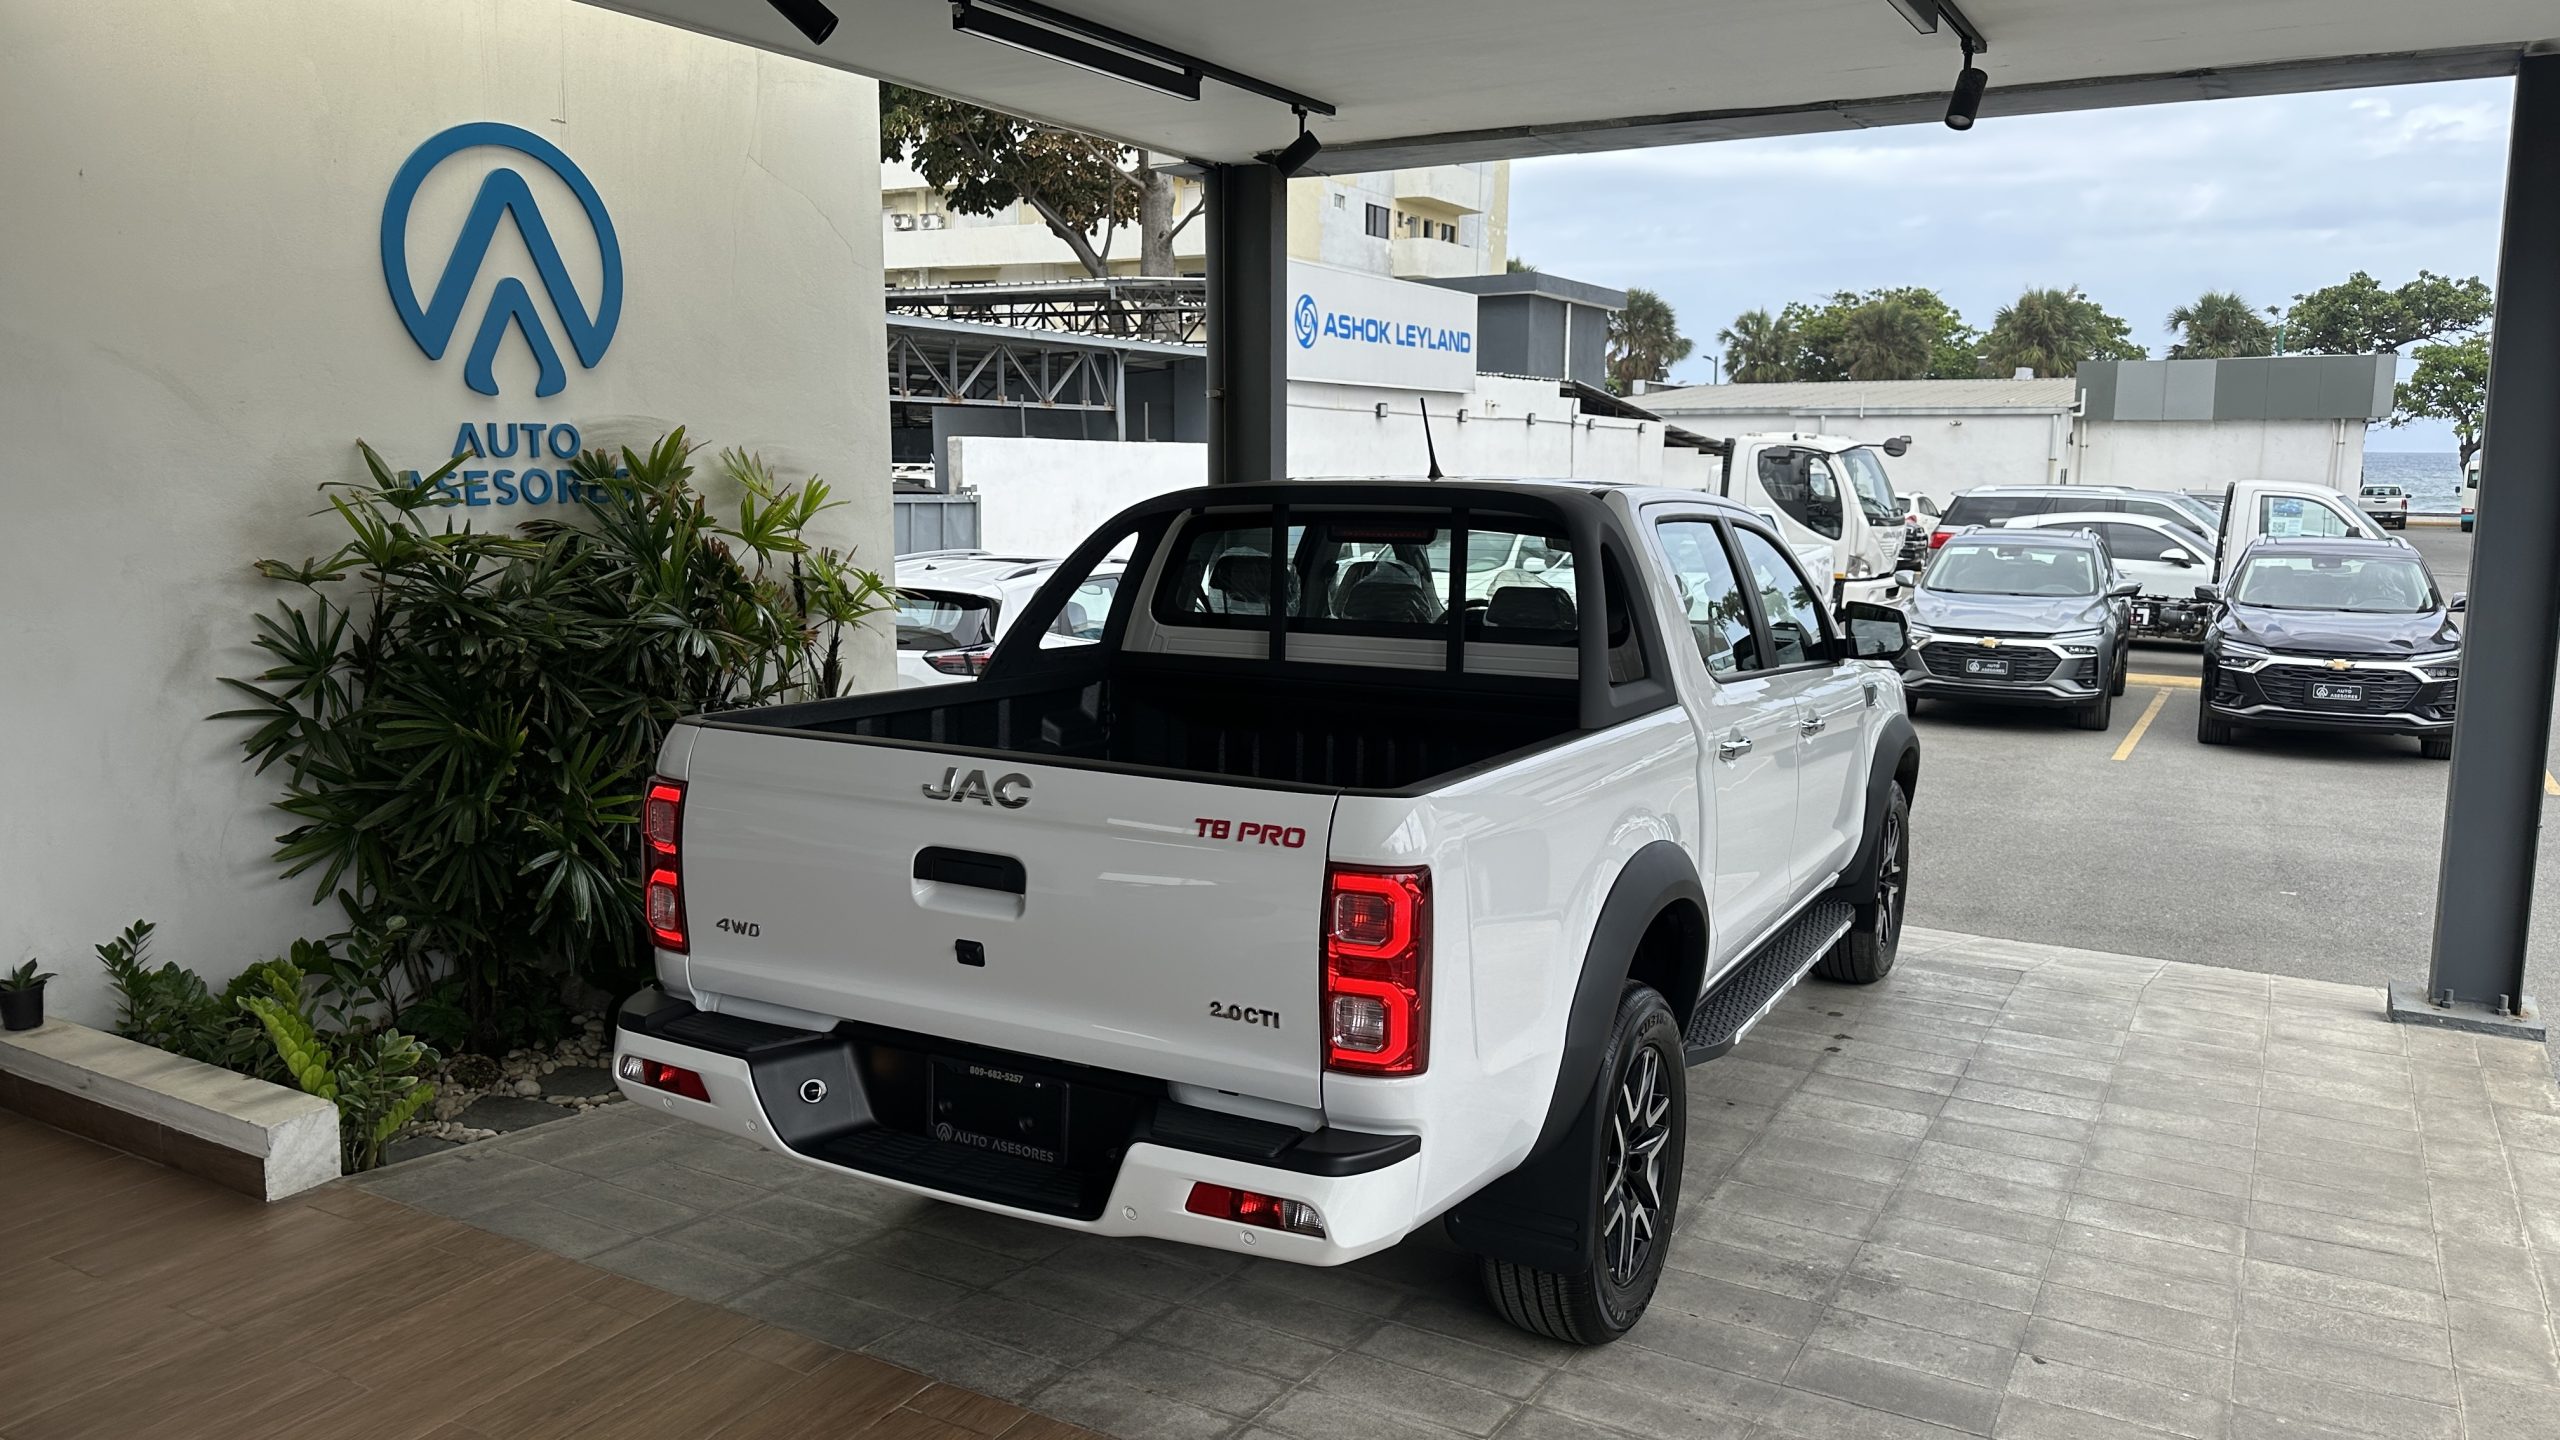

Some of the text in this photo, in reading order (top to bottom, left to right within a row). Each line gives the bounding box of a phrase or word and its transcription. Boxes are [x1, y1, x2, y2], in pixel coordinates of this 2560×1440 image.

[1324, 312, 1471, 354] ASHOK LEYLAND
[452, 422, 581, 459] AUTO
[921, 766, 1035, 810] JAC
[1195, 817, 1306, 849] T8 PRO
[716, 918, 760, 937] 4WD
[969, 1065, 1024, 1084] 809-682-5257
[954, 1131, 1054, 1163] AUTO ASESORES
